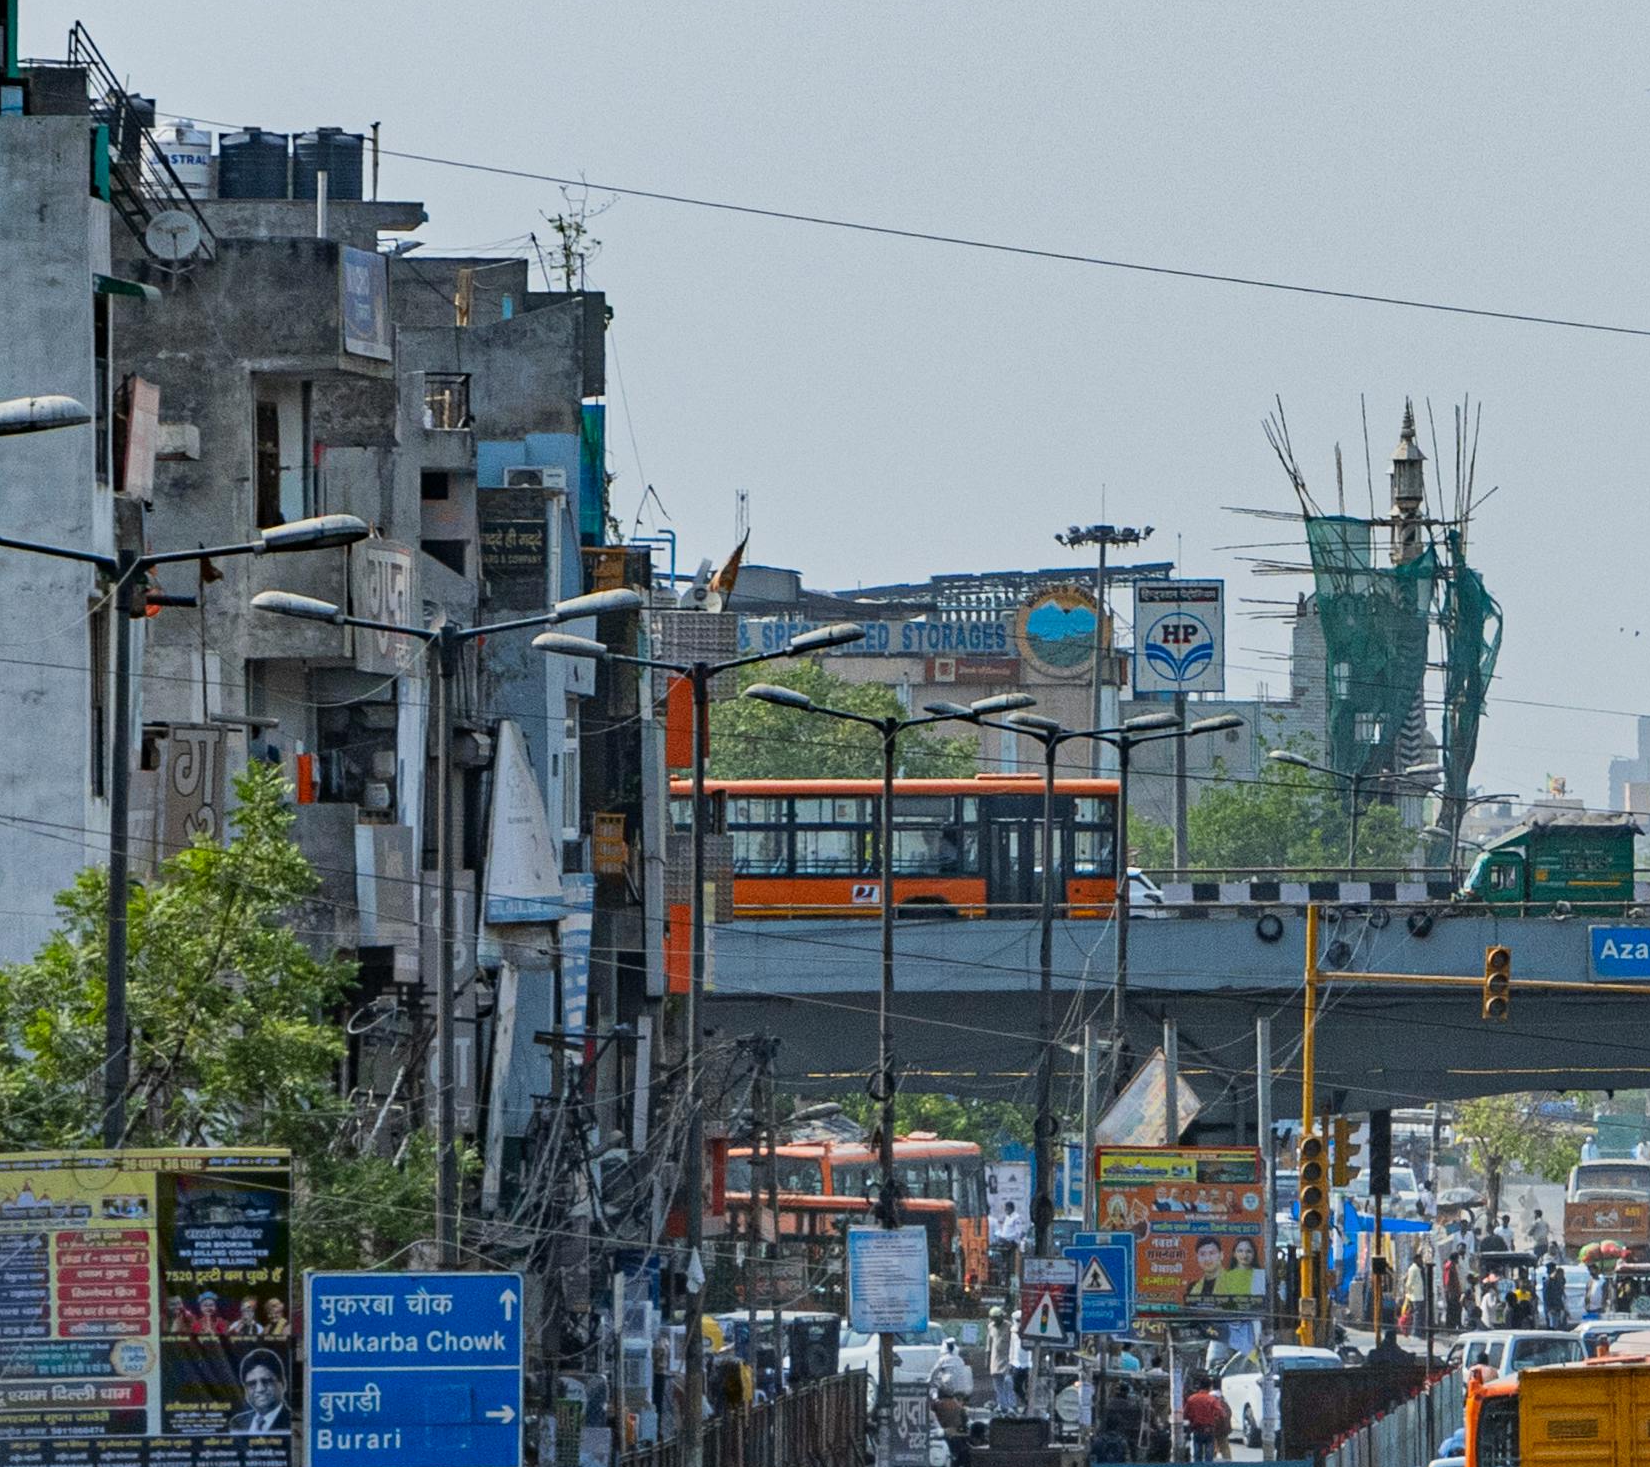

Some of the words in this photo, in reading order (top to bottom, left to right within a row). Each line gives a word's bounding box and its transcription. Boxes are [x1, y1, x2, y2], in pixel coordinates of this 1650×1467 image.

[902, 622, 1007, 650] STORAGES
[1162, 624, 1198, 644] HP
[319, 1294, 394, 1326] मुकरबा
[405, 1287, 453, 1316] चौक
[317, 1332, 418, 1353] Mukarba
[426, 1331, 505, 1352] Chowk
[51, 1384, 96, 1402] दिल्ली
[317, 1429, 401, 1450] Burari
